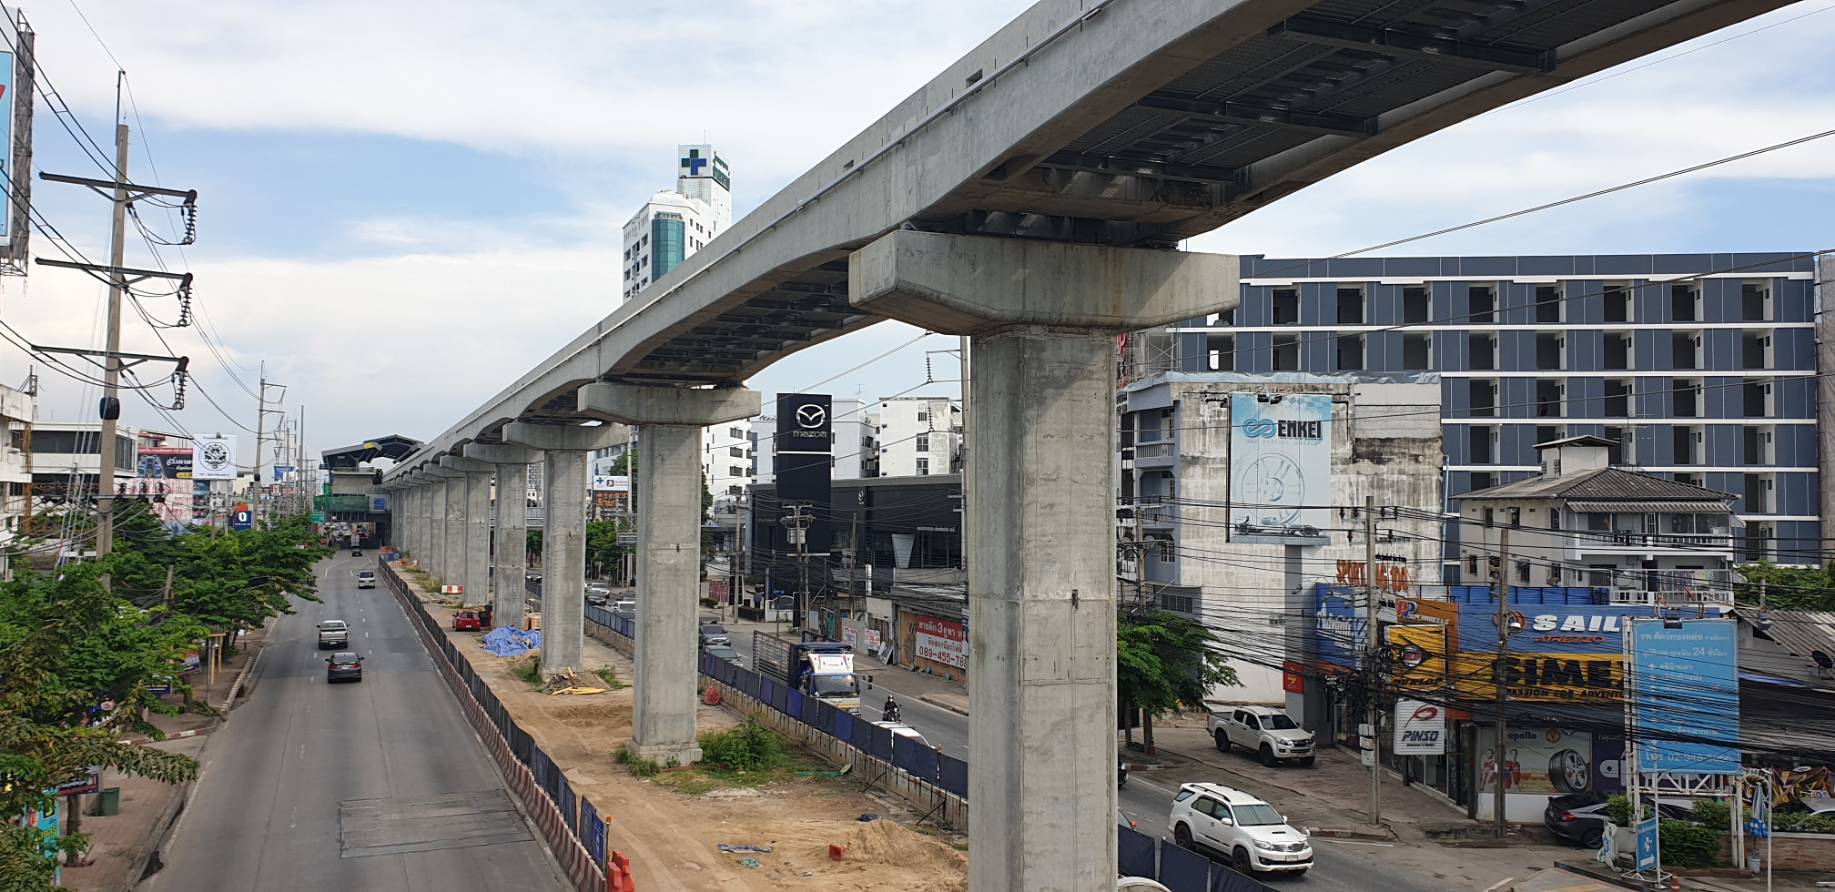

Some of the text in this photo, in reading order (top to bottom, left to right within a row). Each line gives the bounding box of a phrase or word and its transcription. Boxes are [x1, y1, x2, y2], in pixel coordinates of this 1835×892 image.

[1278, 420, 1322, 439] ENKEI
[1693, 647, 1705, 656] 24
[1402, 730, 1439, 741] PINSO
[1507, 730, 1537, 741] apollo
